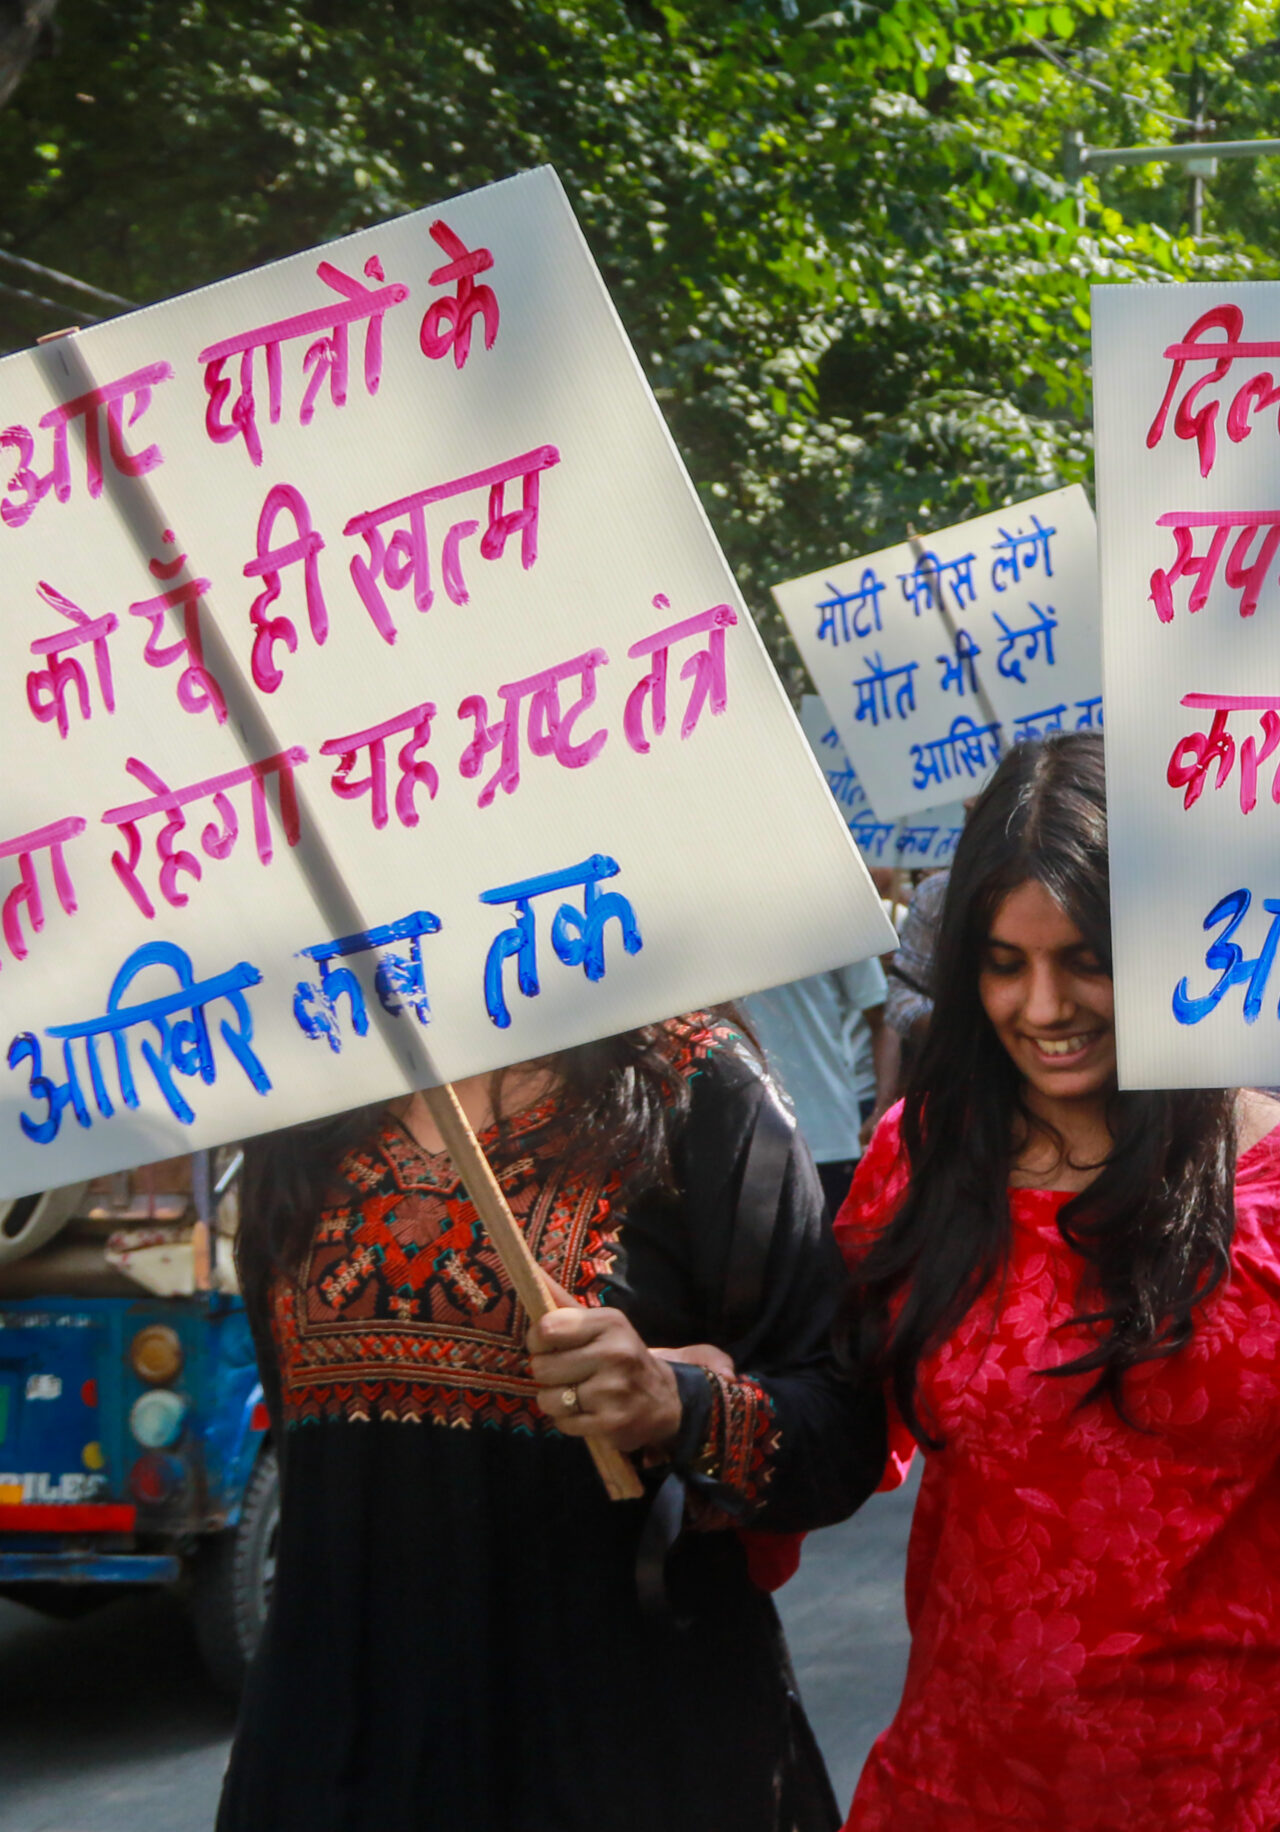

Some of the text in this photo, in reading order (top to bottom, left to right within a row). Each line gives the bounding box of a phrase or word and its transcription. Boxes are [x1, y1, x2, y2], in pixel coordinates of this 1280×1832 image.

[0, 361, 176, 528] आए
[420, 219, 500, 369] के
[26, 581, 119, 739] को
[243, 484, 328, 694] ही
[343, 444, 560, 645] खत्म
[815, 568, 885, 646] मोटी
[896, 550, 977, 617] फीस
[853, 651, 919, 726] मौत
[936, 628, 982, 696] भी
[0, 593, 738, 961] ता रहेगा यह भ्रष्ट तंत्र
[909, 714, 1002, 791] आखिर
[6, 854, 642, 1144] आखिर कब तक
